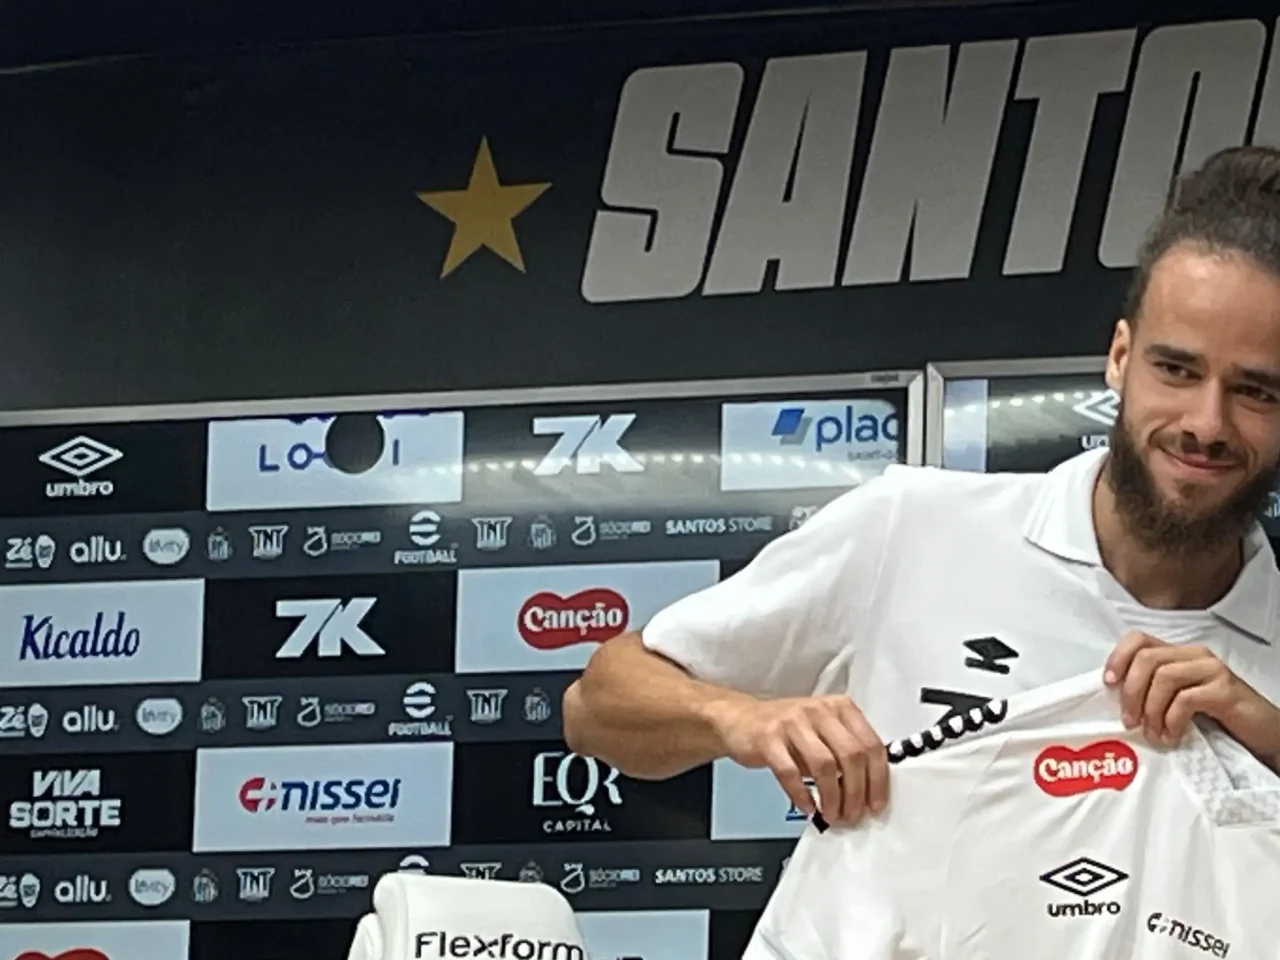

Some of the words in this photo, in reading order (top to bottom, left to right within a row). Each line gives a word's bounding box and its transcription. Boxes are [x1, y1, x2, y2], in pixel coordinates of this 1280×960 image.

[532, 412, 645, 476] 7K
[46, 478, 114, 498] umbro
[665, 518, 726, 534] SANTOS
[728, 516, 773, 532] STORE
[274, 597, 386, 659] 7K
[522, 603, 624, 636] Canção
[19, 610, 140, 662] Kicaldo
[1039, 751, 1135, 784] Canção
[32, 769, 101, 797] VIVA
[281, 777, 402, 811] nissei
[9, 799, 121, 828] SORTE
[543, 819, 612, 833] CAPITAL
[655, 868, 716, 883] SANTOS
[718, 867, 764, 882] STORE
[1047, 899, 1121, 917] umbro
